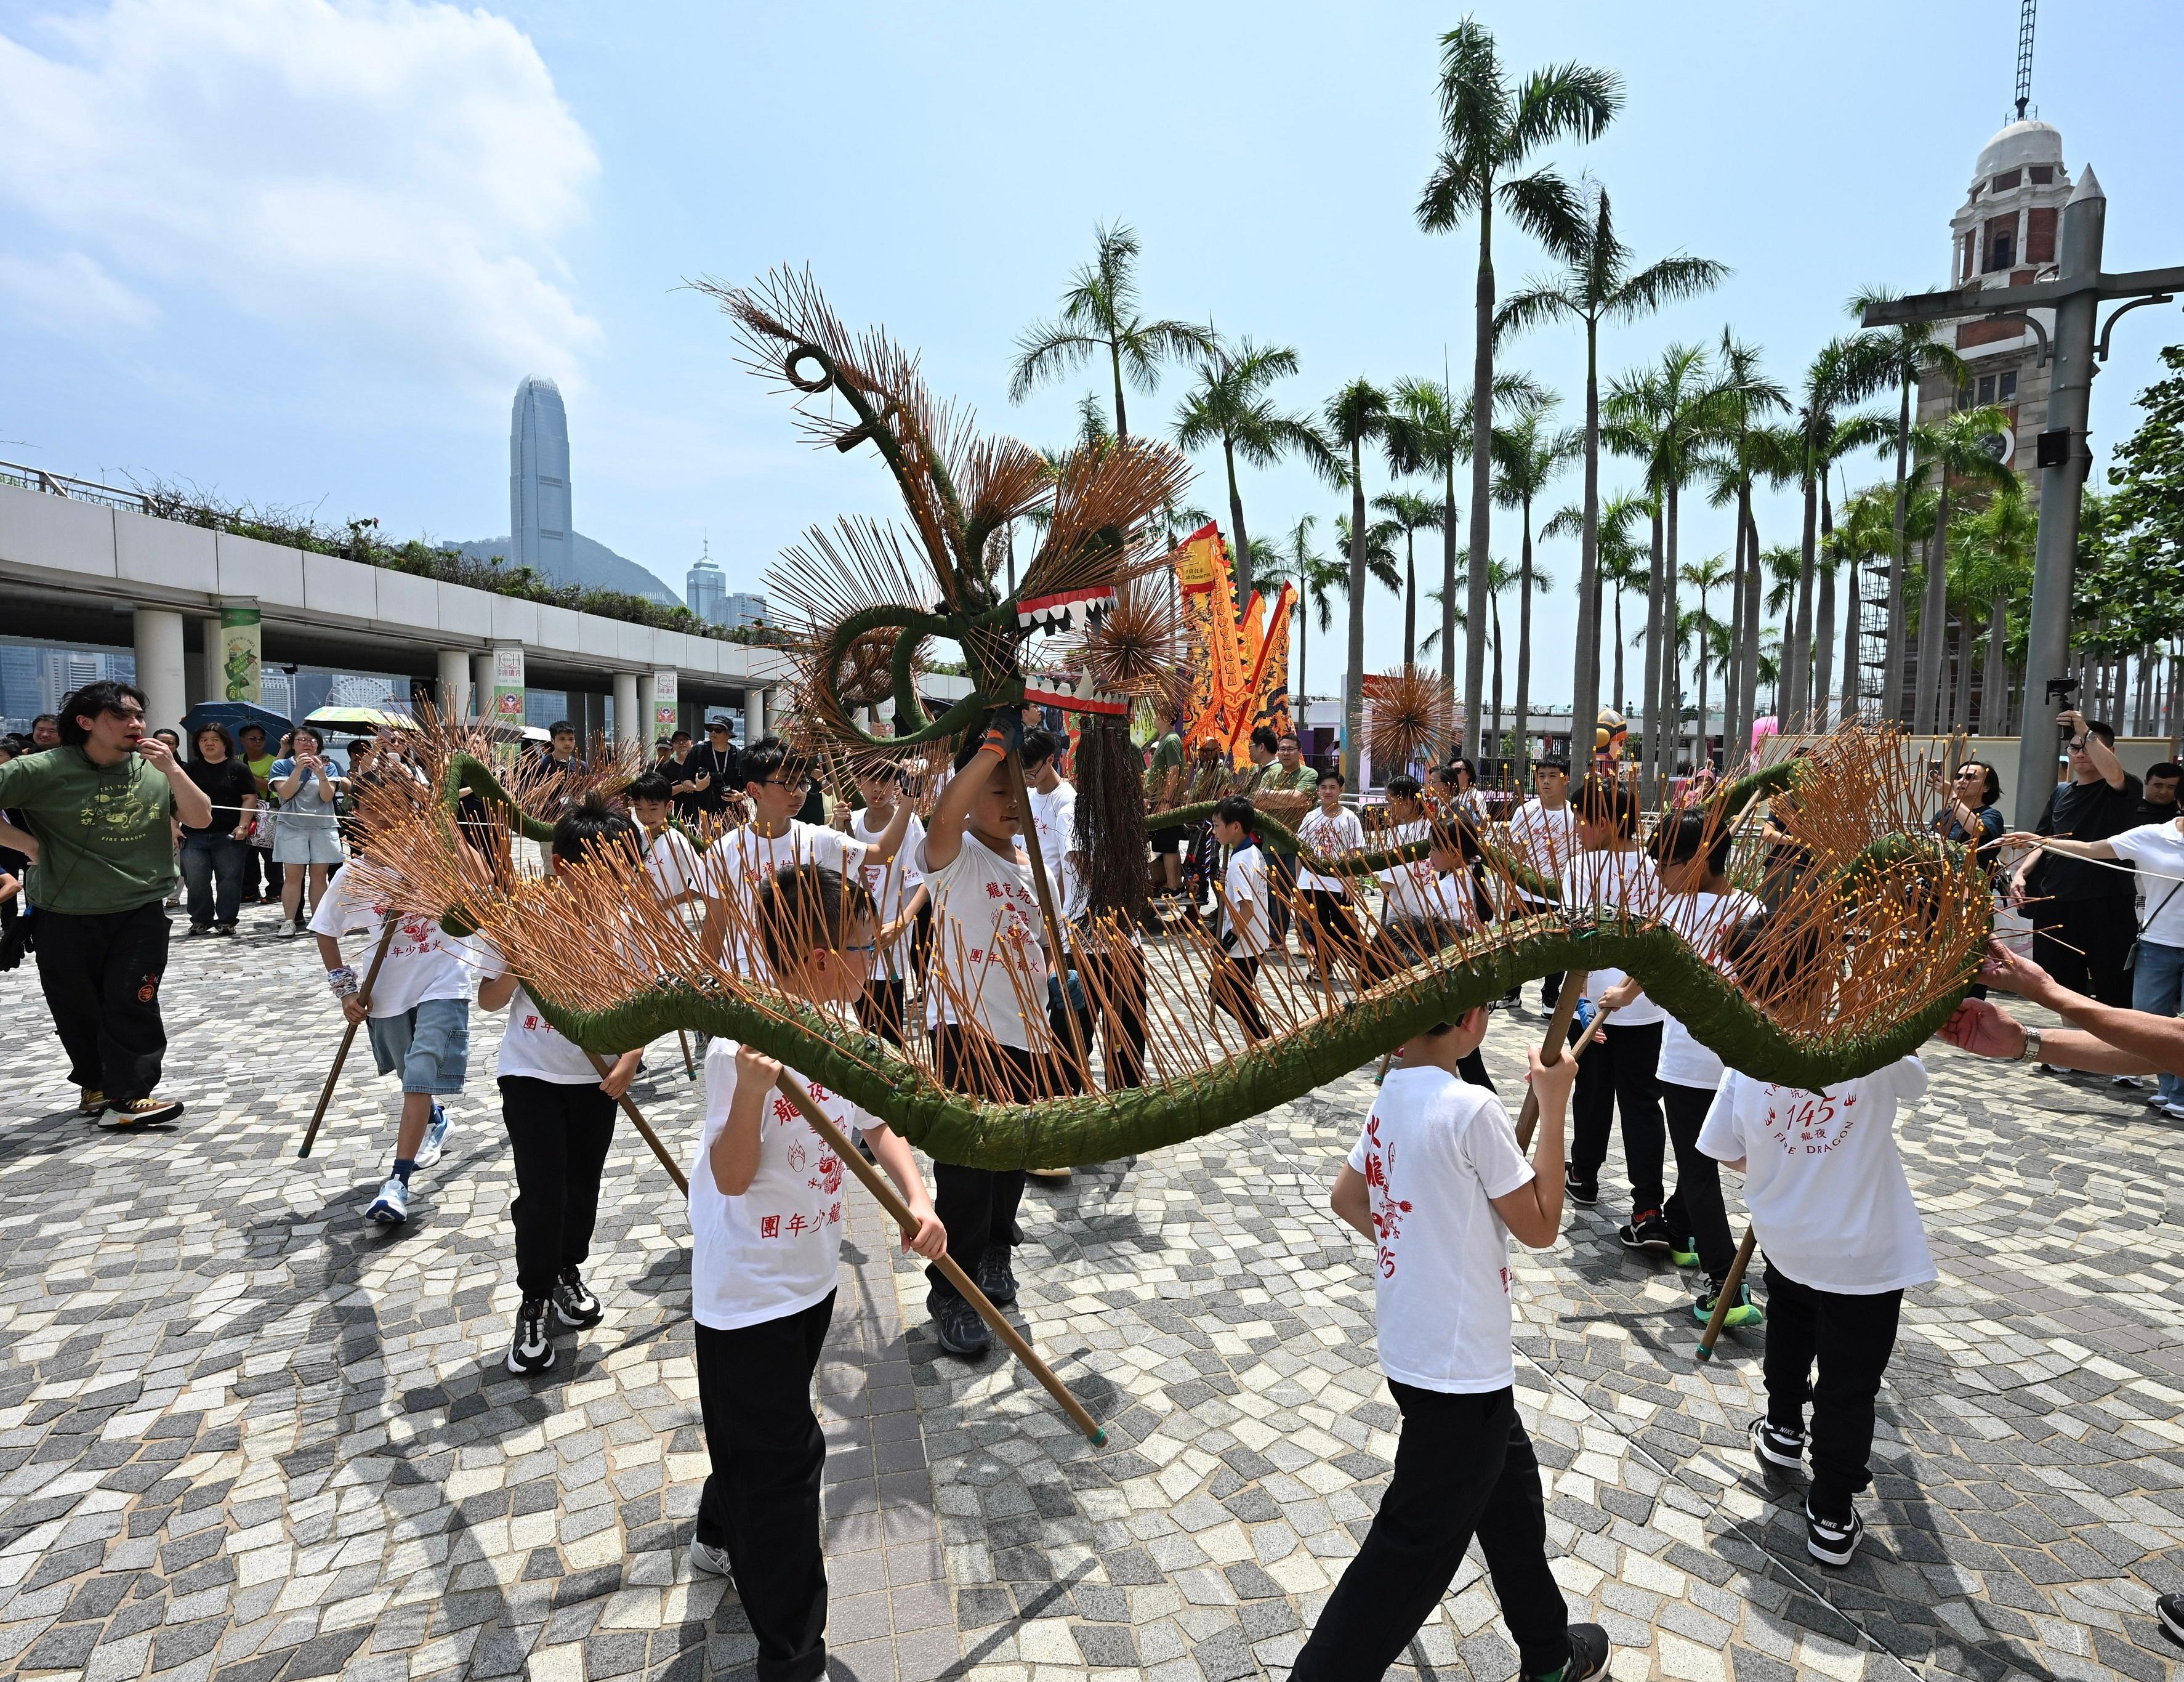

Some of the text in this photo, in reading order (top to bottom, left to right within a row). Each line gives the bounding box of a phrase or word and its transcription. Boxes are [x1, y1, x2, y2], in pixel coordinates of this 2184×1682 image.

[81, 807, 95, 826] 大坑
[148, 803, 161, 820] 火龍
[120, 833, 147, 842] DRAGON
[847, 847, 858, 865] 2025
[904, 871, 919, 881] 2025
[1787, 1096, 1837, 1131] 145
[1773, 1121, 1855, 1155] FIRE DRAGON
[1779, 1426, 1795, 1437] NIKE
[1819, 1518, 1839, 1529] NIKE
